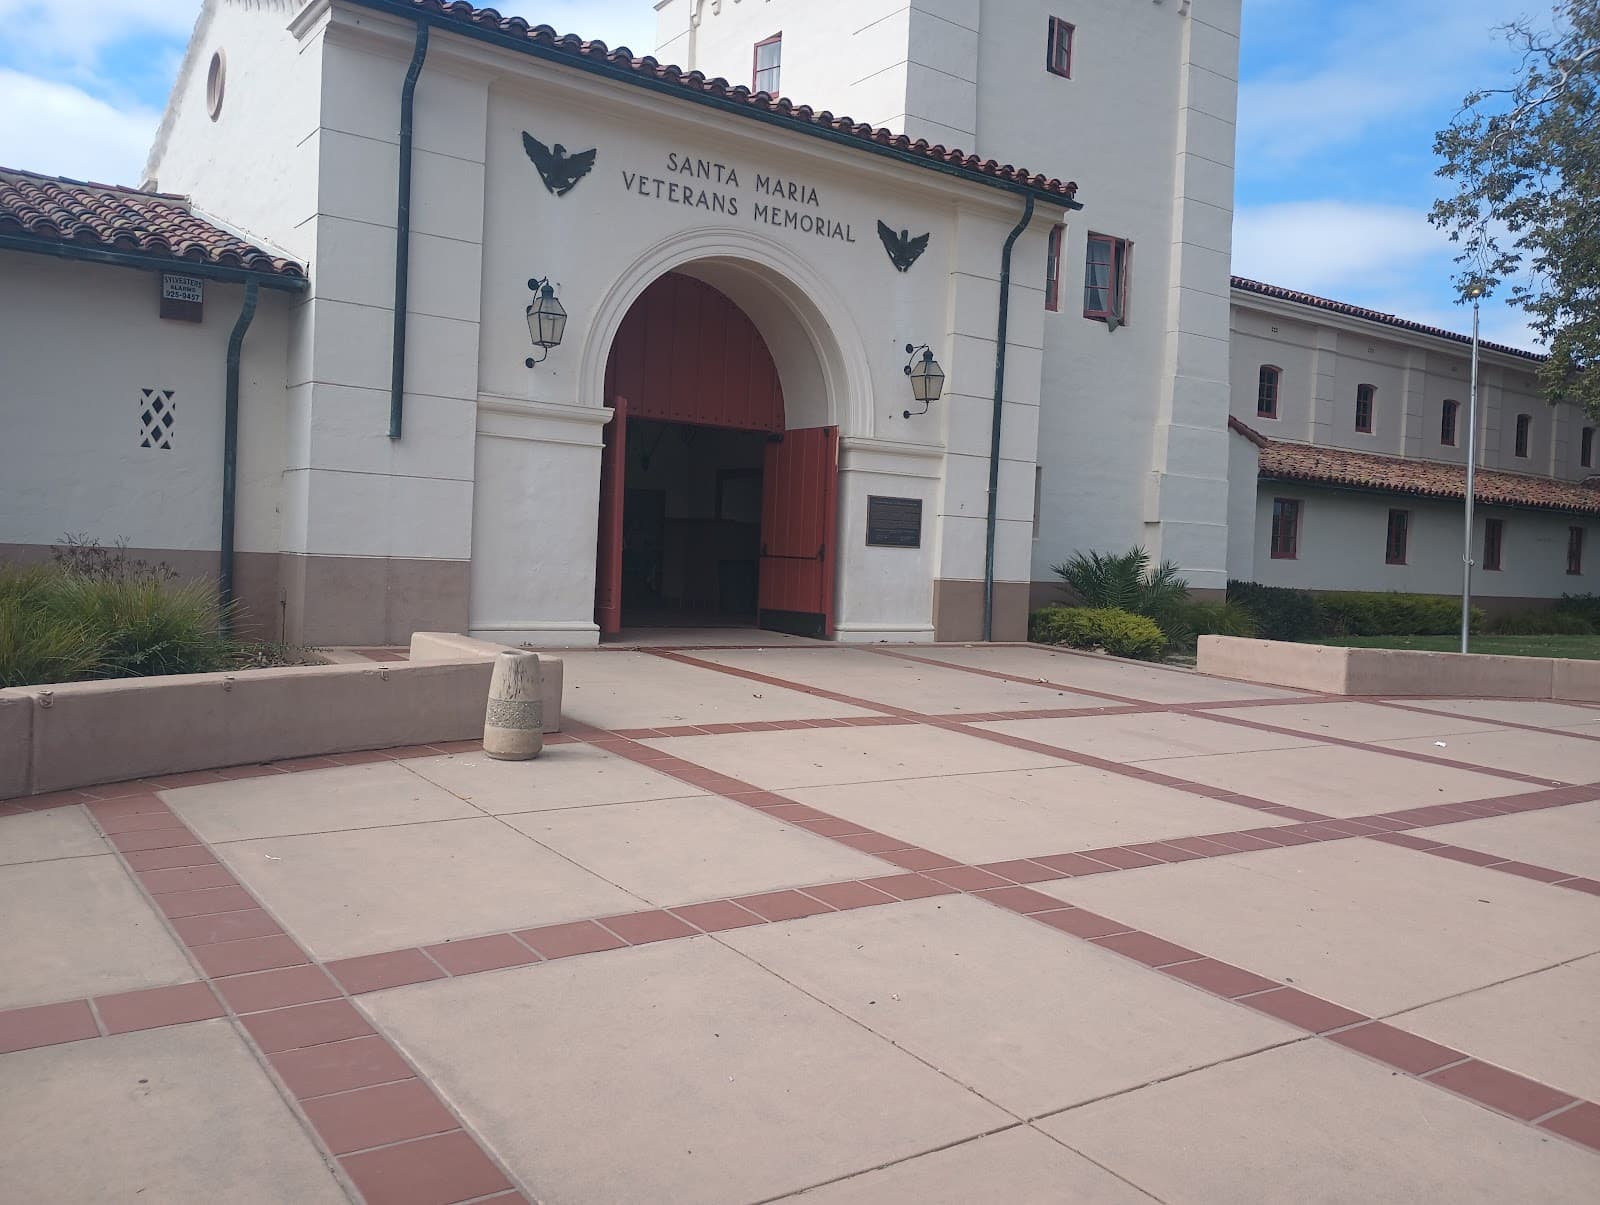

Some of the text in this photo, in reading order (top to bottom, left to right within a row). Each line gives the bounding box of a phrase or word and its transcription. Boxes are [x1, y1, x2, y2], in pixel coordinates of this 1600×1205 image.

[622, 170, 856, 243] VETERANS MEMORIAL
[666, 152, 819, 207] SANTA MARIA
[170, 284, 196, 293] ALARMS
